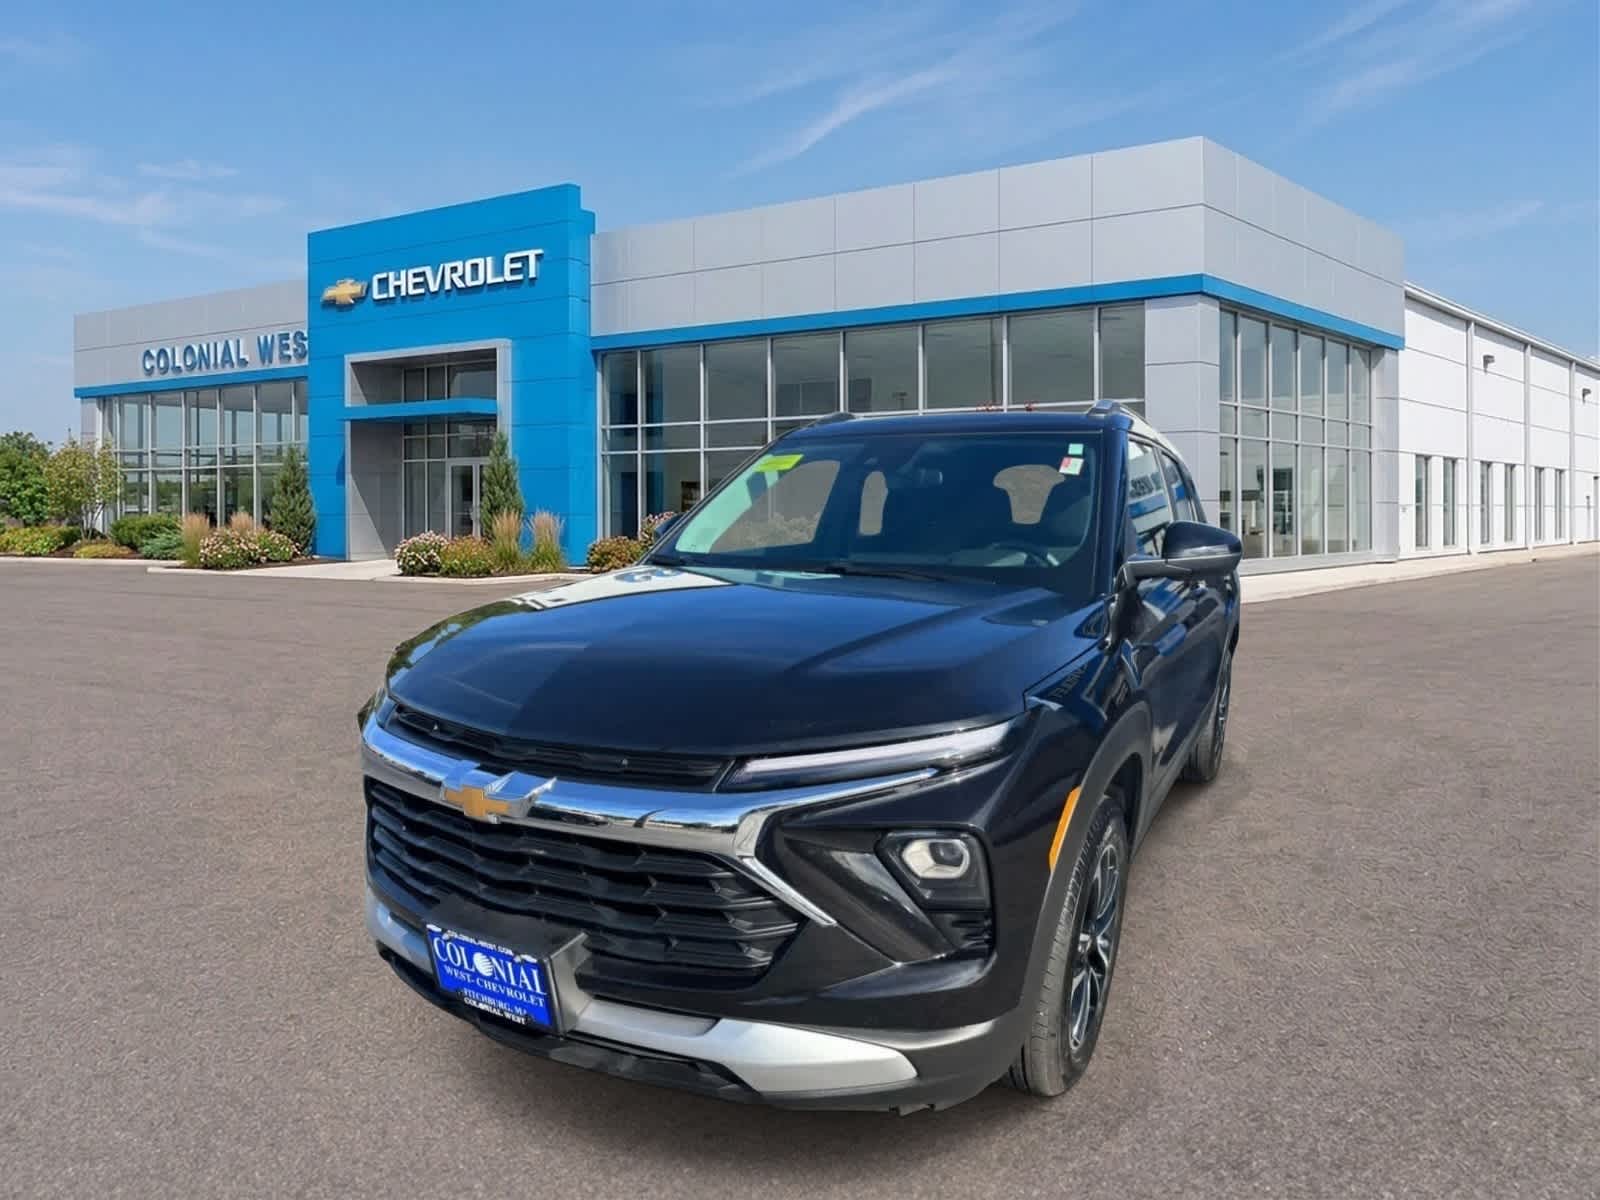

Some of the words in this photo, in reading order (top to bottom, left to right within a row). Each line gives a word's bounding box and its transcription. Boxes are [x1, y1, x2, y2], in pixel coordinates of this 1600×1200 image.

[372, 249, 544, 300] CHEVROLET
[142, 339, 249, 376] COLONIAL
[476, 977, 545, 1007] CHEVROLET
